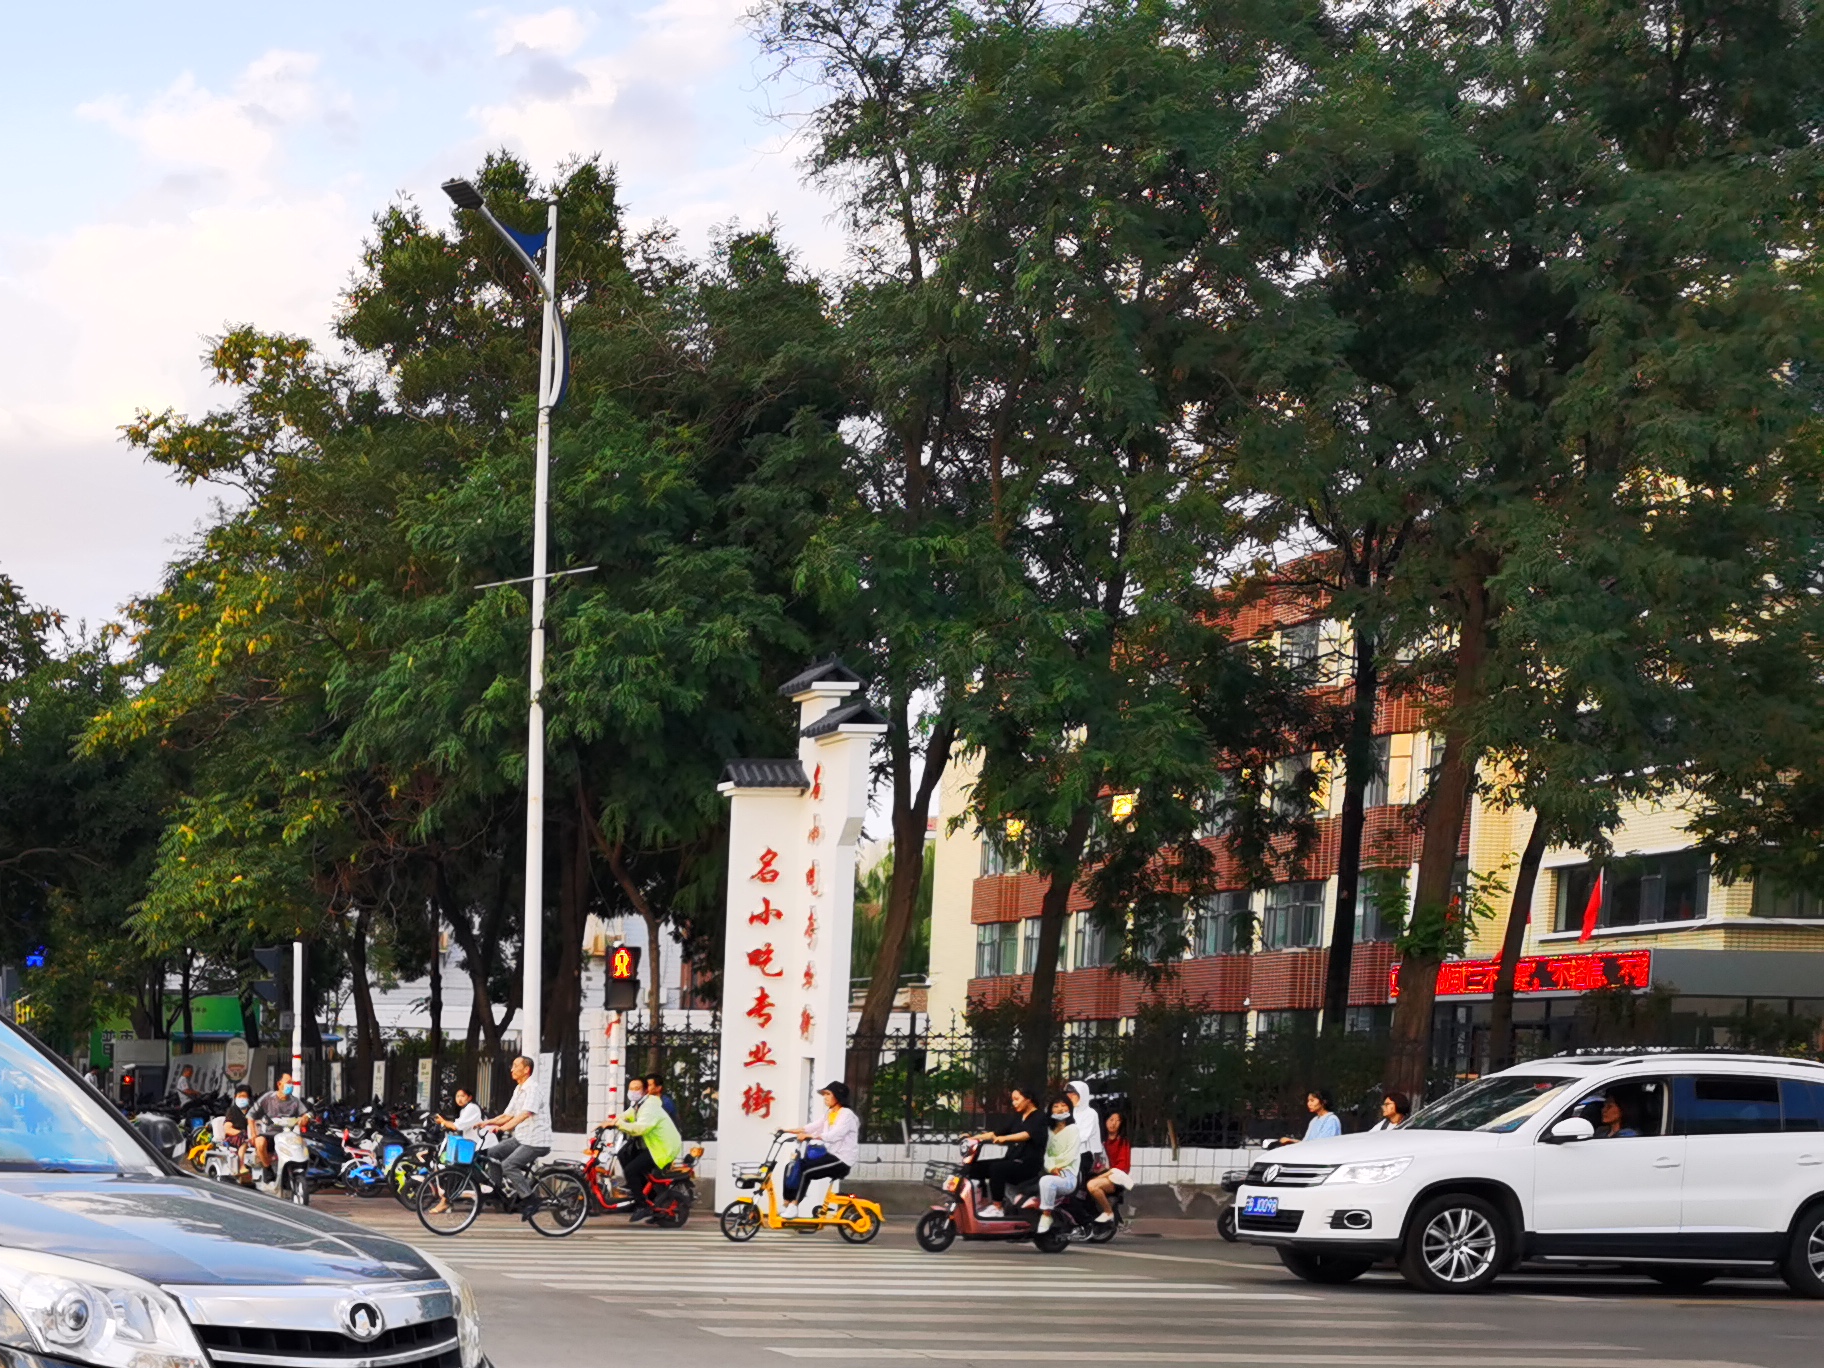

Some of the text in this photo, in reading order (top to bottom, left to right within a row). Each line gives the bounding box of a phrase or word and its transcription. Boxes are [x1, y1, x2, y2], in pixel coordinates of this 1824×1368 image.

[741, 846, 784, 1119] 名小吃专业街
